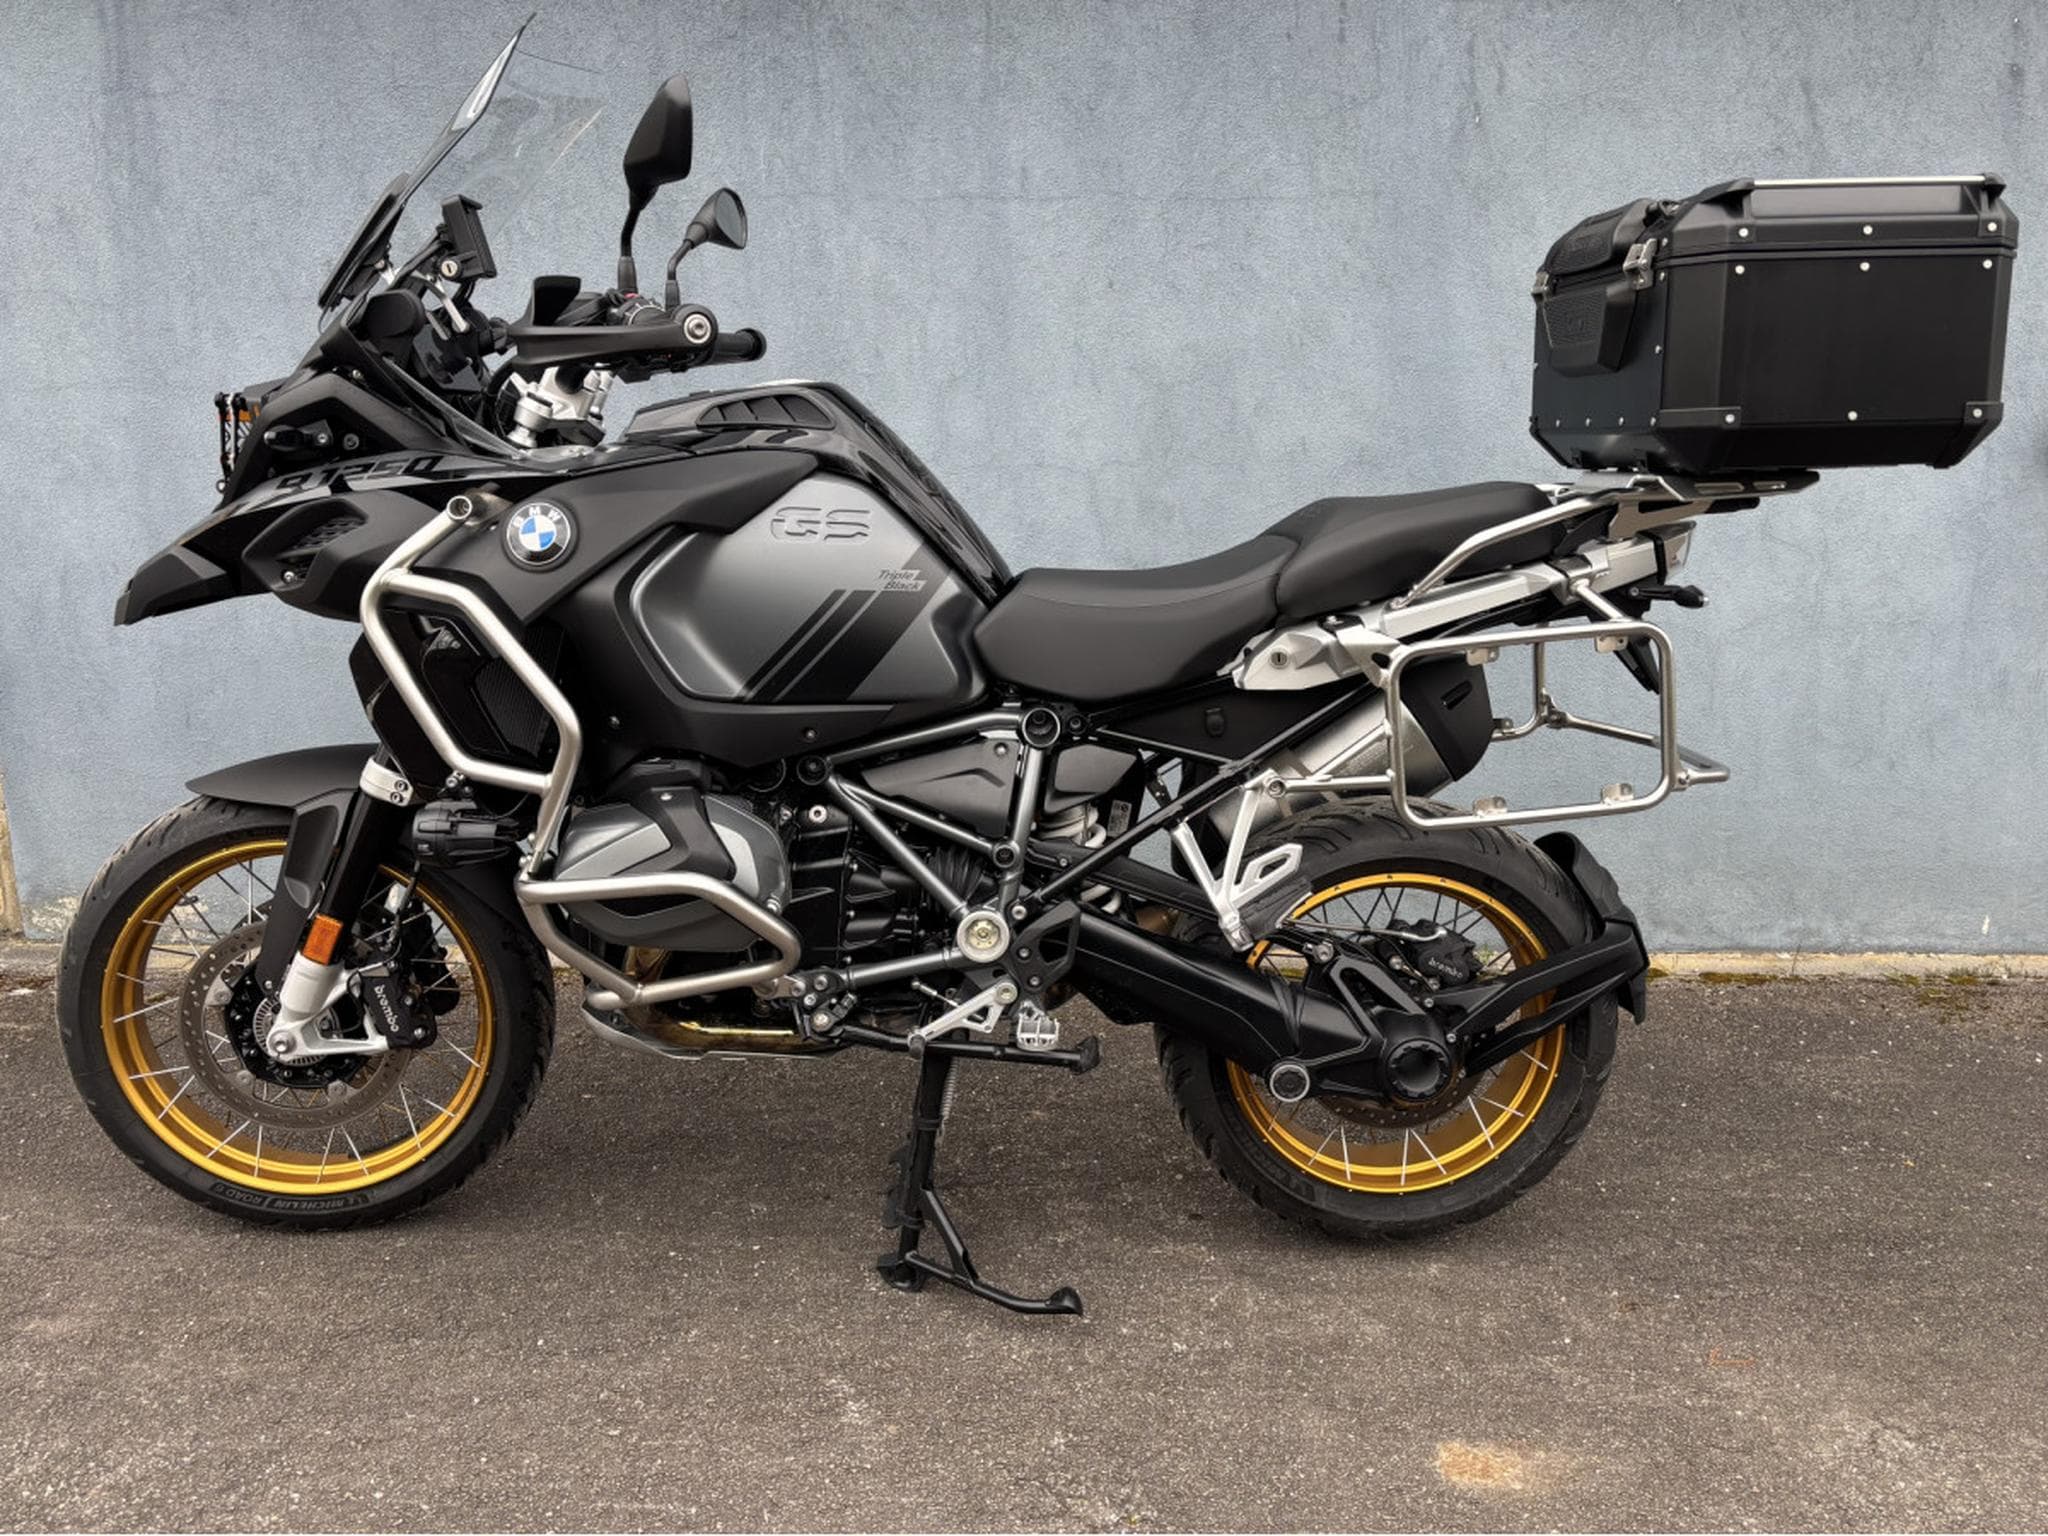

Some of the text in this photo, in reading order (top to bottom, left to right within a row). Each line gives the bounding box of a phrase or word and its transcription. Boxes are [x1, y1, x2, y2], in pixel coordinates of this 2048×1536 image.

[512, 505, 562, 528] BMW
[770, 506, 872, 545] GS
[879, 569, 915, 581] Triple
[884, 580, 920, 591] Black
[1428, 957, 1463, 979] brembo
[374, 984, 399, 1032] brembo
[226, 1188, 263, 1204] ROAD
[273, 1198, 345, 1211] MICHELIN
